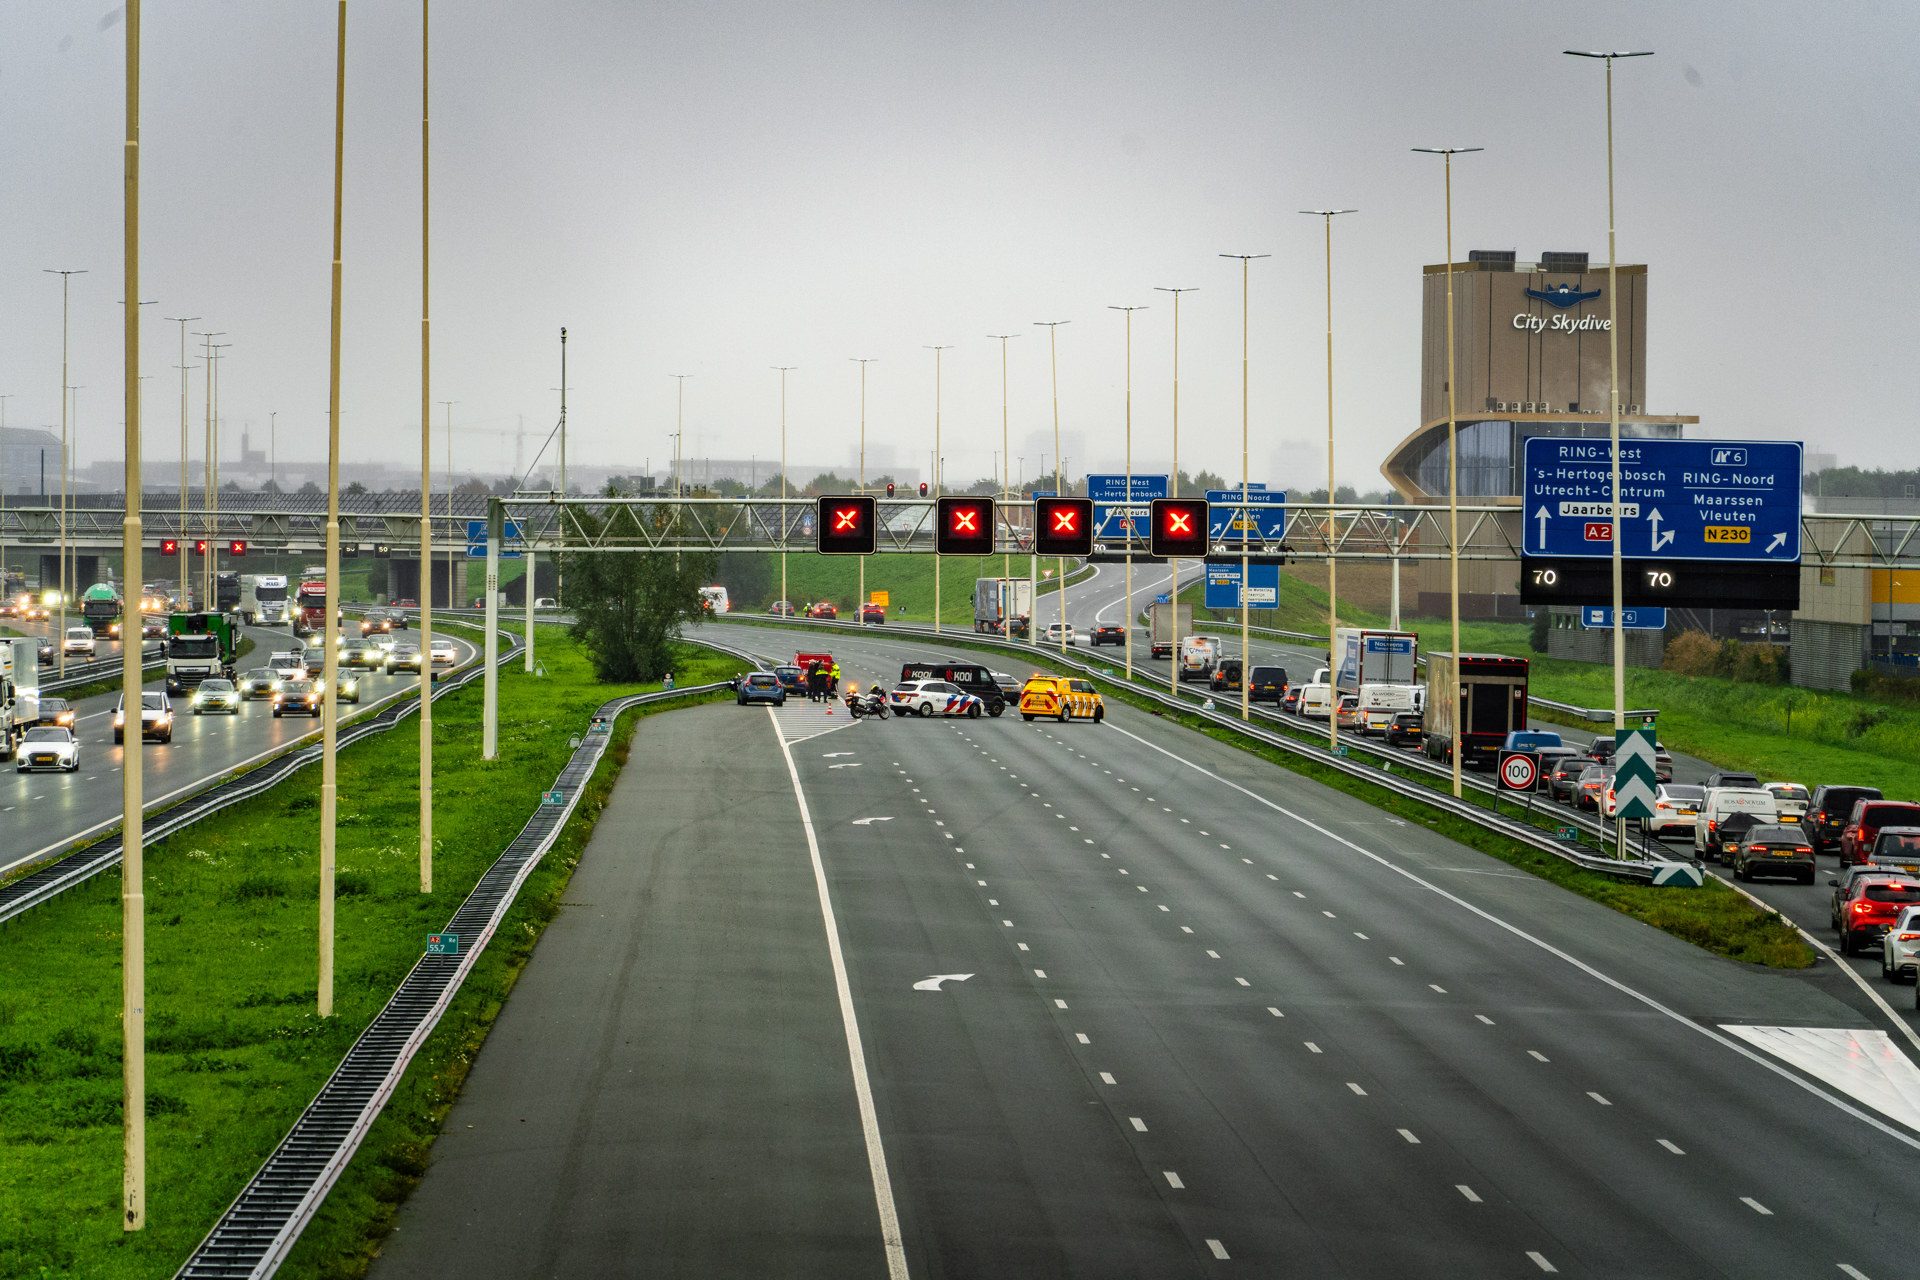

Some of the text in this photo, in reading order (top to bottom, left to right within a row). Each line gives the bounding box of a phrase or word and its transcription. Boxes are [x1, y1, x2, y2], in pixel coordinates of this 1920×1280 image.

[1513, 313, 1611, 334] City Skydive
[1733, 453, 1742, 462] 6
[1683, 473, 1774, 485] RING-Noord
[1221, 493, 1270, 501] RINGNoord
[1534, 485, 1665, 498] Utrecht-Cntrum
[1694, 494, 1763, 506] Maarssen
[1562, 504, 1637, 516] Jaarbers
[1700, 510, 1756, 522] Vleuten
[1588, 526, 1610, 538] A2
[1533, 570, 1556, 585] 70
[1648, 572, 1672, 587] 70
[1508, 765, 1530, 779] 100
[429, 944, 445, 953] 55,7
